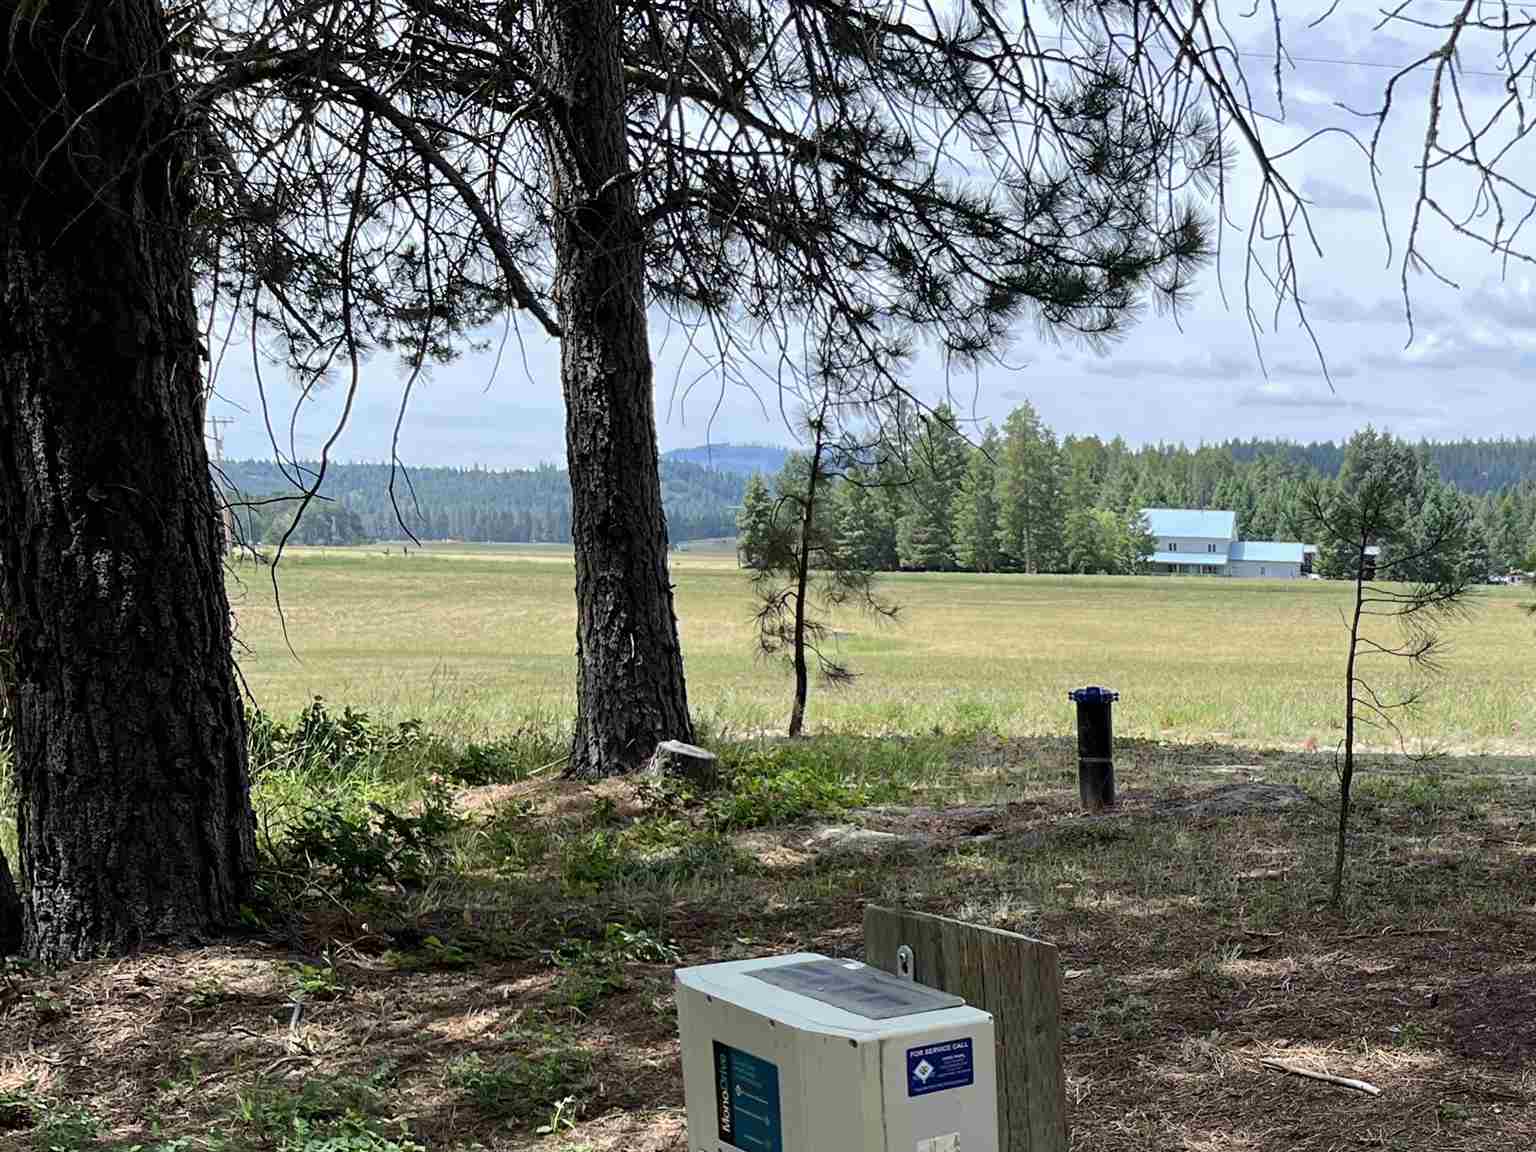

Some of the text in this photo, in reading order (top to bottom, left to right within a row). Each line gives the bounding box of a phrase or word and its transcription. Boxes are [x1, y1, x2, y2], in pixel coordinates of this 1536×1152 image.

[910, 1041, 969, 1058] FOR SERVICE CALL
